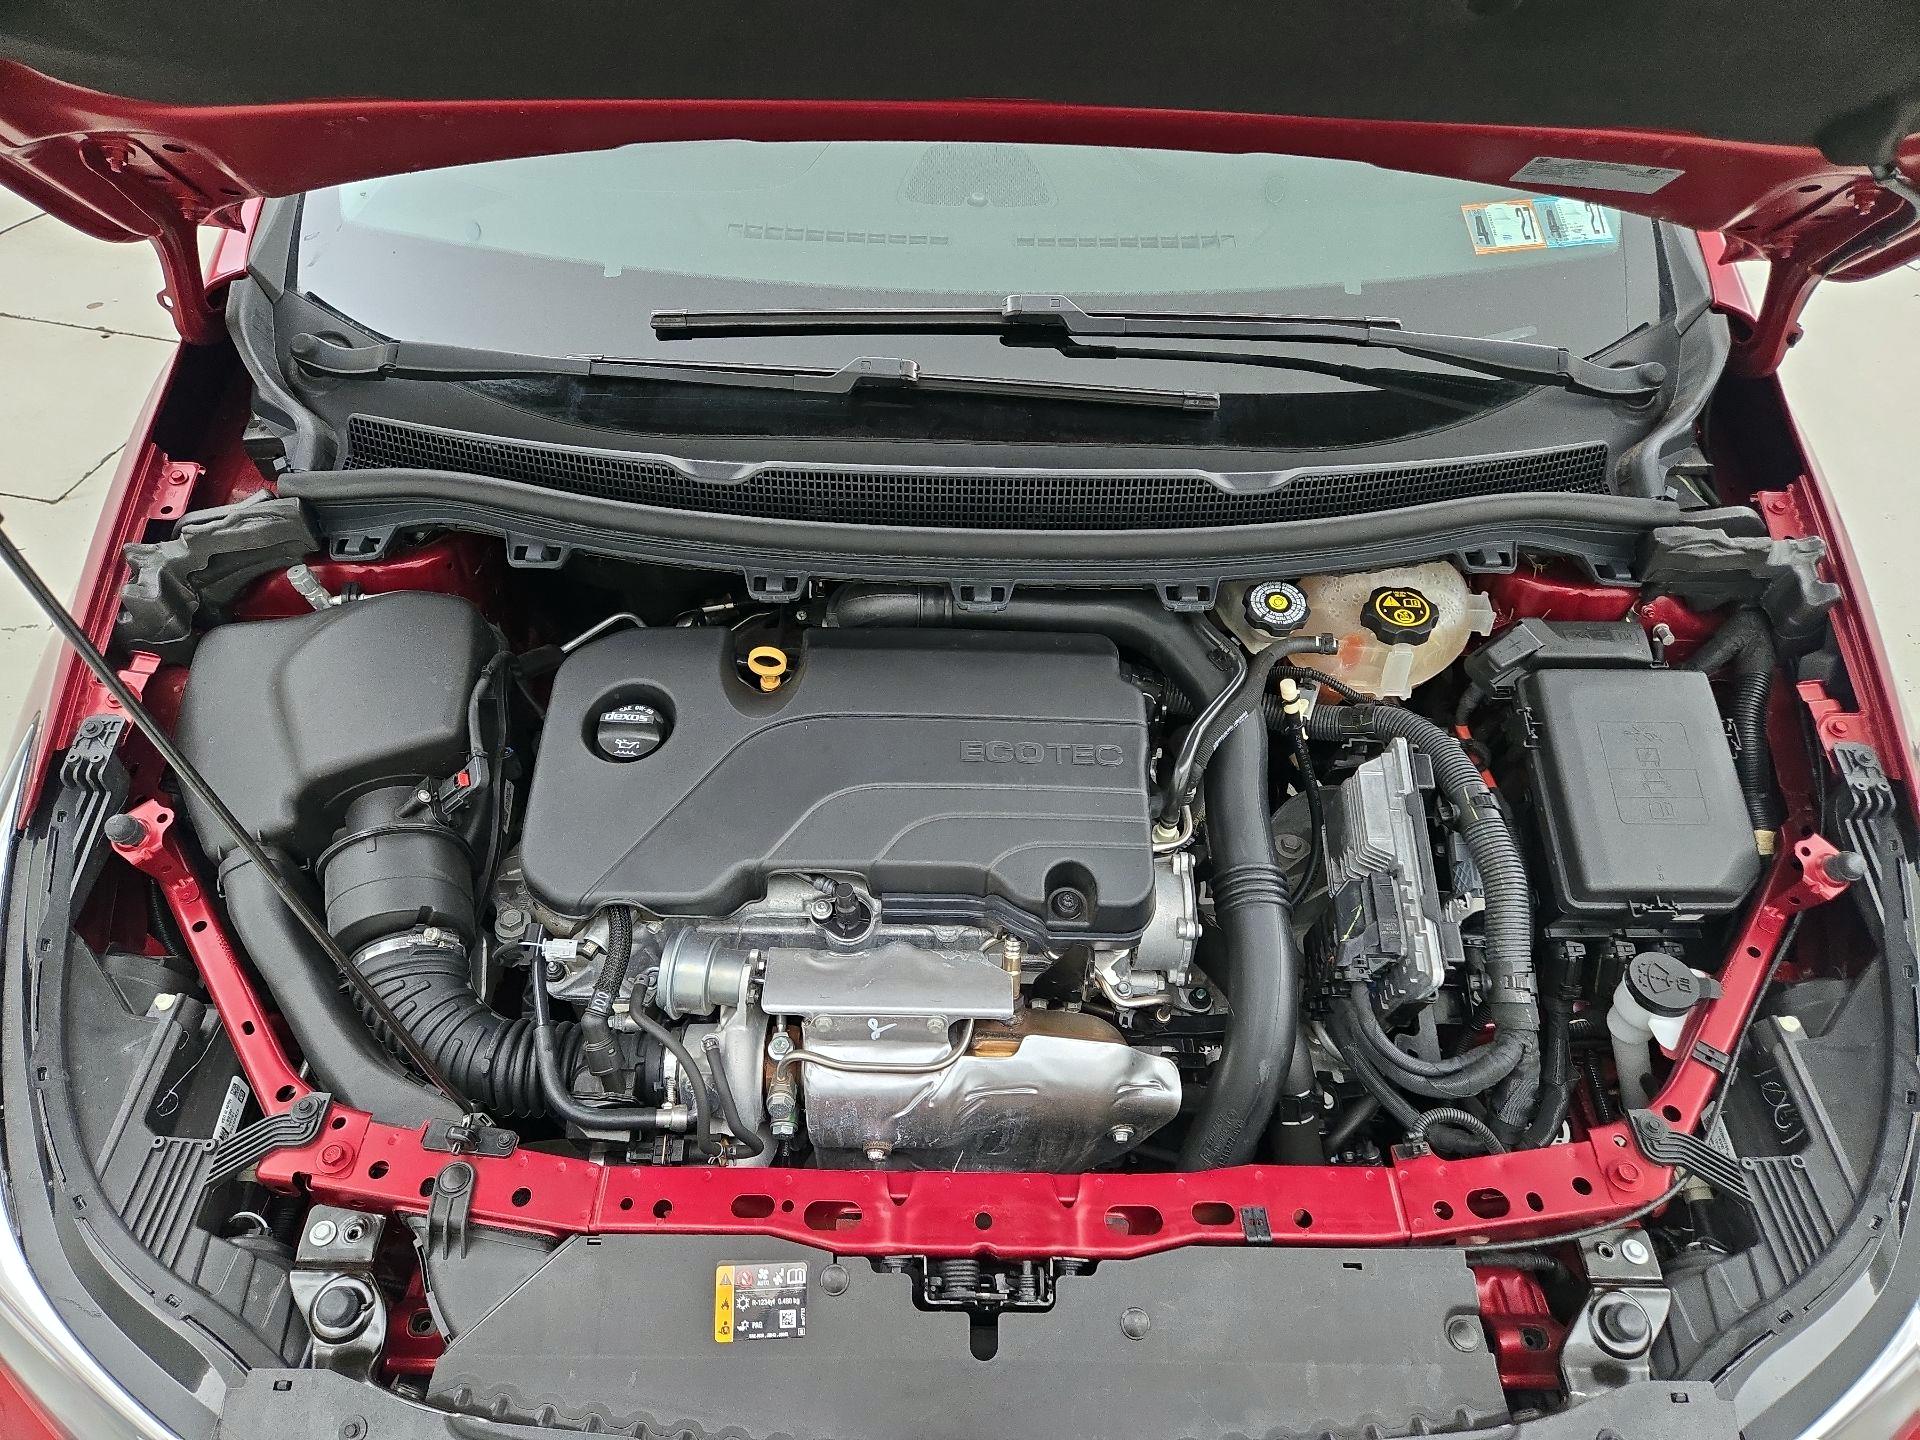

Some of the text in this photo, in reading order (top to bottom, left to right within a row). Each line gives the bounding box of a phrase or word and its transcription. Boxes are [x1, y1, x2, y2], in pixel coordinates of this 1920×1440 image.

[1475, 215, 1491, 245] 4
[604, 711, 648, 722] dexos
[959, 740, 1124, 767] ECOTEC
